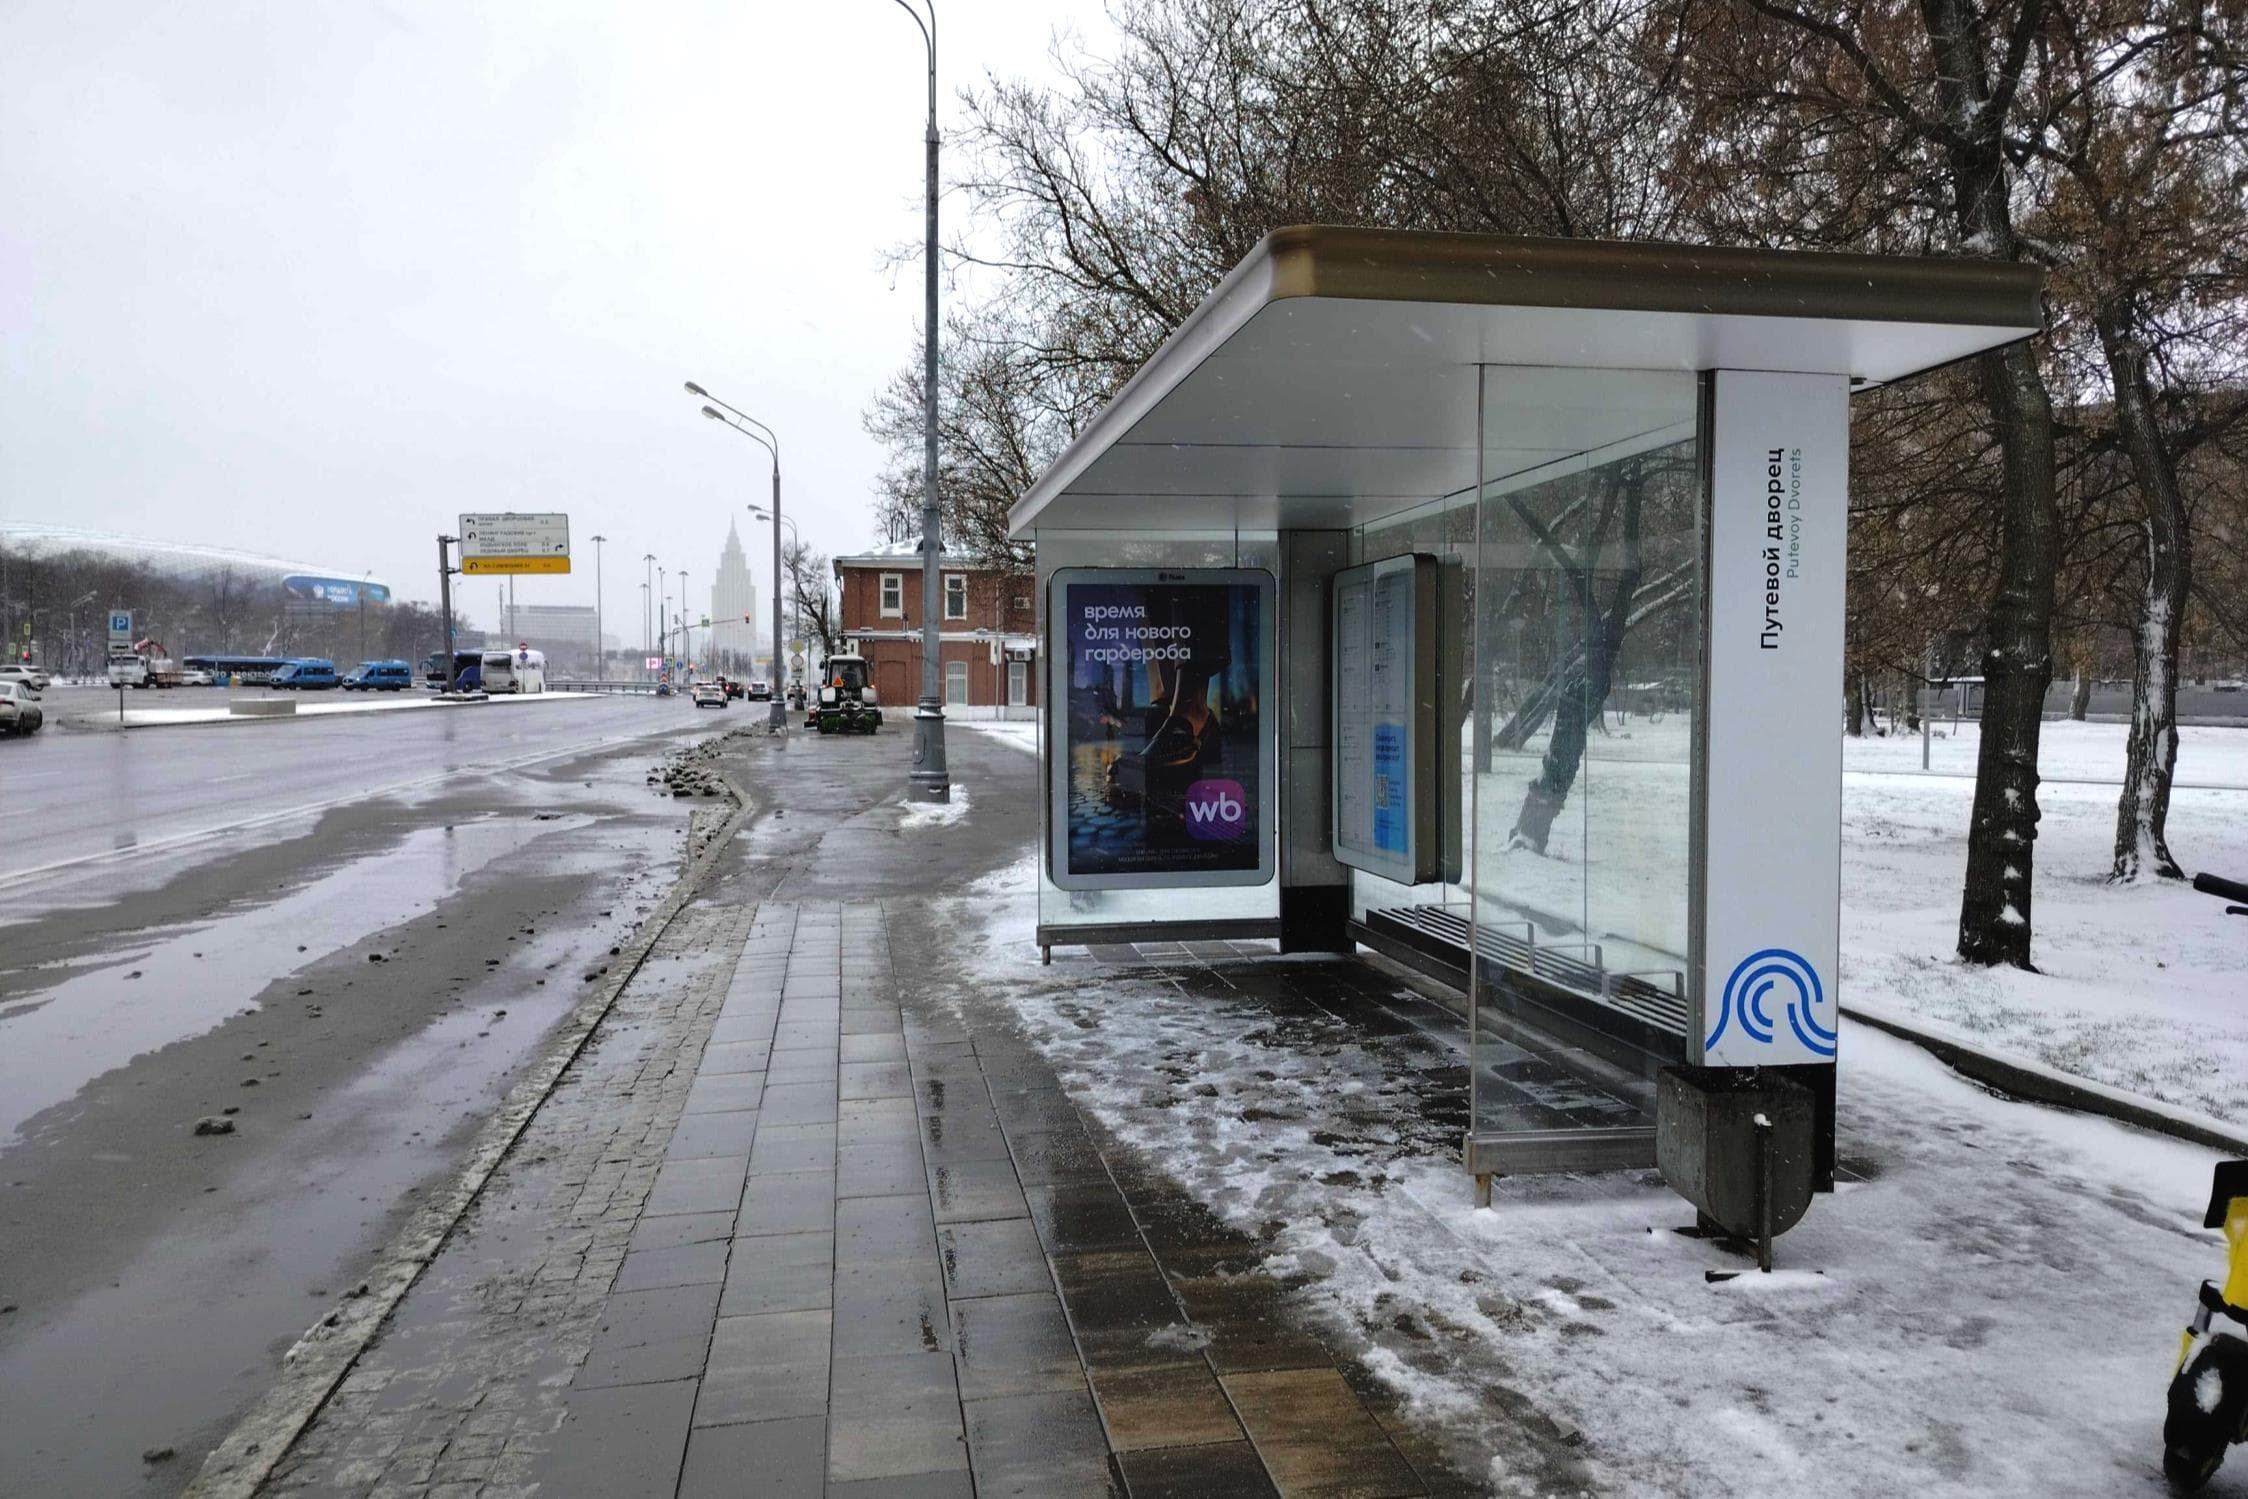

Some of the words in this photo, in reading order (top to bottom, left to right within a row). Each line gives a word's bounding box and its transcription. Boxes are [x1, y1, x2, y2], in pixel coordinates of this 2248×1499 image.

[1767, 447, 1786, 541] дворец
[1787, 447, 1803, 511] Dvorets
[1786, 514, 1804, 579] Putevoy
[1084, 605, 1146, 623] время
[1760, 546, 1784, 650] Путевой
[1084, 622, 1120, 641] для
[1125, 626, 1192, 640] нового
[1084, 642, 1192, 665] гардероба
[1189, 791, 1242, 823] wb
